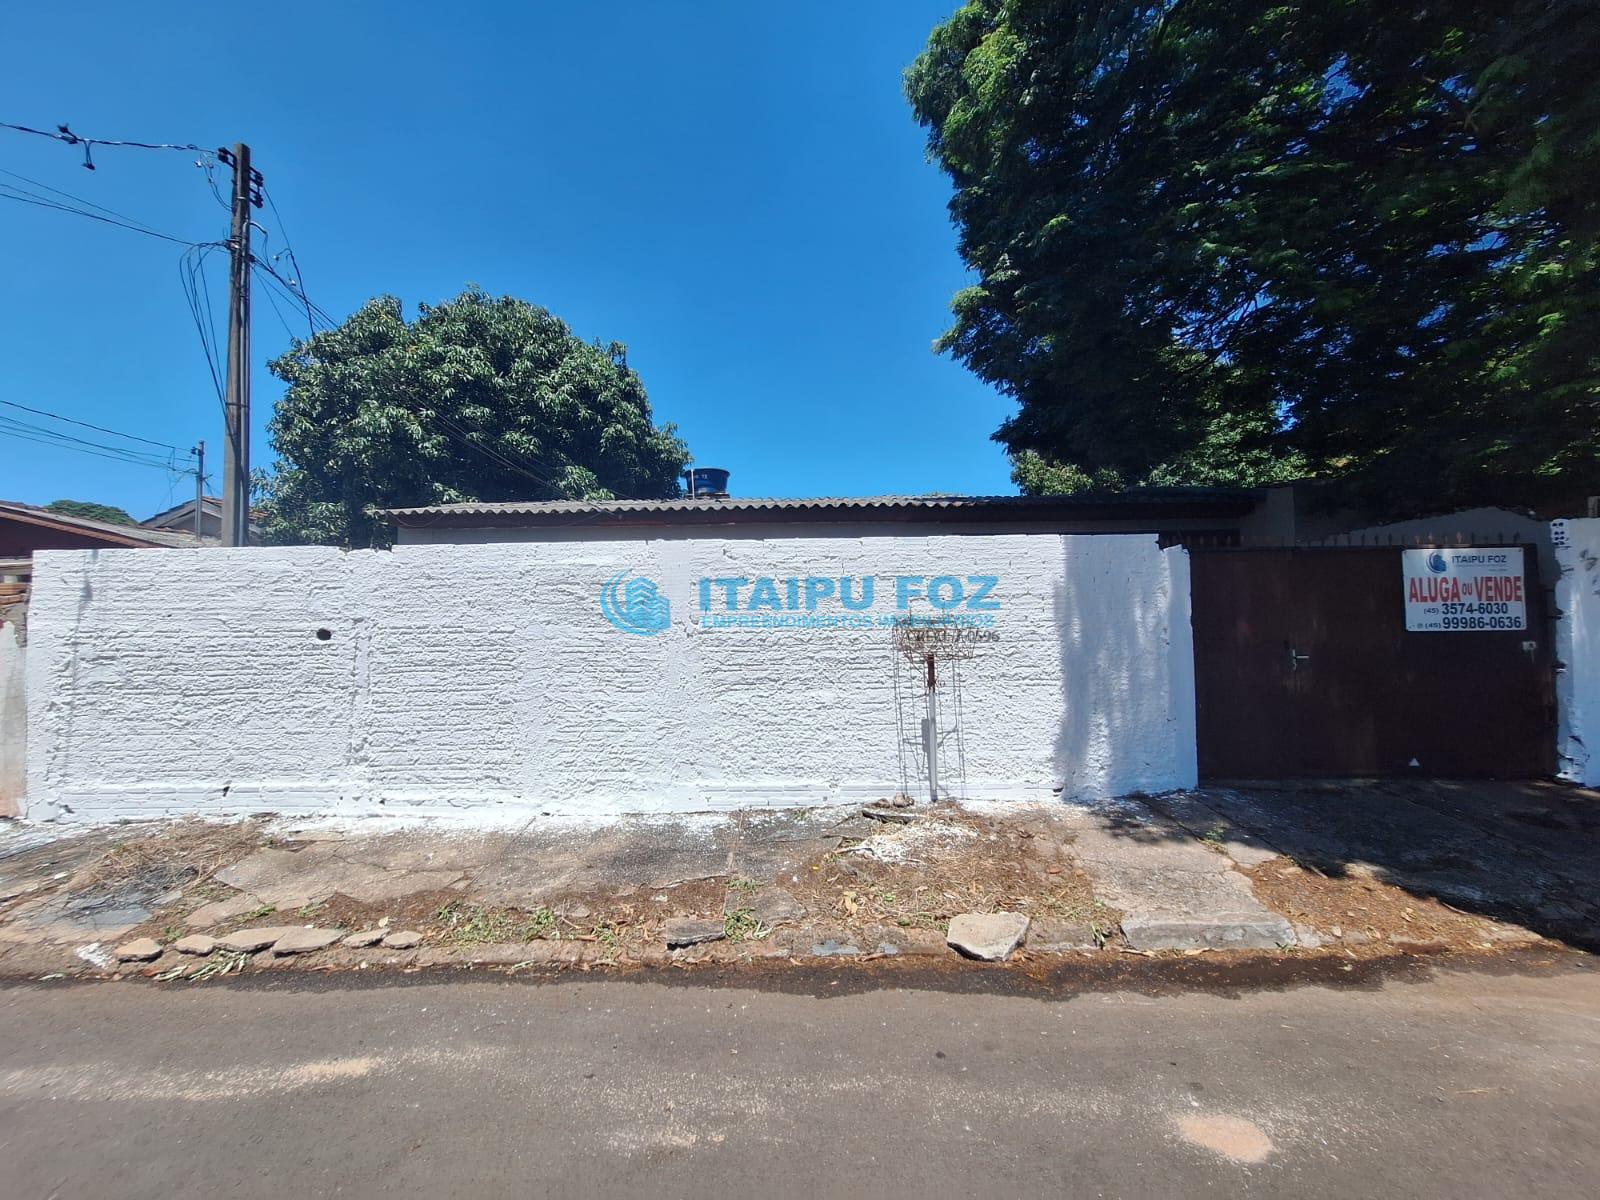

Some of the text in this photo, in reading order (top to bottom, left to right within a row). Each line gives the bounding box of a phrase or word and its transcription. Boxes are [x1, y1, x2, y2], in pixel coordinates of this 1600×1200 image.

[1452, 555, 1507, 564] ITAIPU FOZ
[1409, 576, 1523, 602] ALUGA OU VENDE
[1441, 602, 1509, 615] 3574-6030
[1442, 616, 1522, 629] 99986-0636
